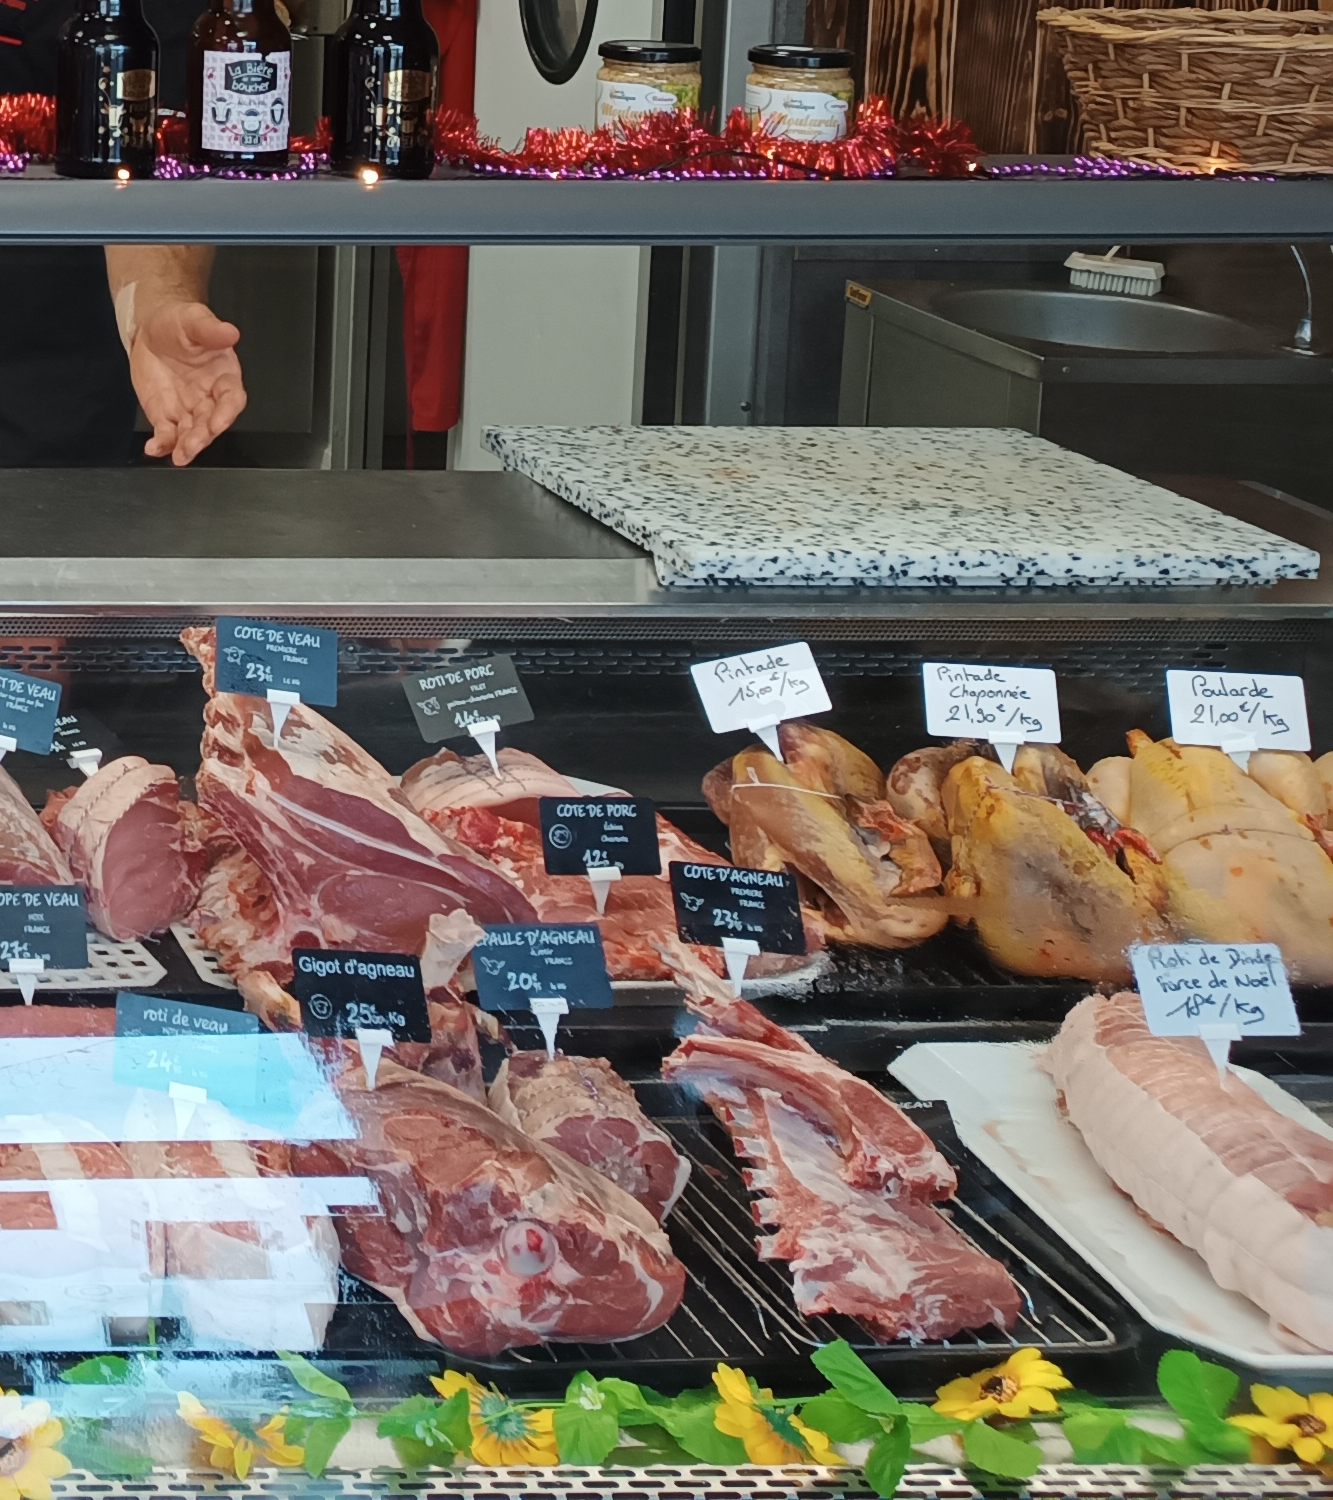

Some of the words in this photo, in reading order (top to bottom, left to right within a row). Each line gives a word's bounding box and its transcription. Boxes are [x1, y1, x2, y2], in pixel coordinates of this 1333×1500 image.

[228, 65, 241, 77] La
[246, 62, 274, 76] Bière
[231, 81, 270, 94] boucher
[233, 625, 265, 641] COTE
[265, 629, 285, 644] DE
[287, 631, 321, 649] VEAU
[282, 654, 309, 665] FRANCE
[714, 654, 790, 683] Pintade
[418, 672, 446, 691] ROTI
[445, 670, 464, 685] DE
[463, 663, 495, 681] PORC
[936, 665, 1007, 683] Pintade
[8, 679, 25, 694] DE
[27, 683, 57, 702] VEAU
[494, 686, 519, 698] FRANCE
[949, 683, 1032, 707] Chaponnée
[1191, 674, 1275, 699] Poularde
[5, 701, 29, 713] FRANCE
[556, 804, 586, 818] COTE
[586, 804, 605, 818] DE
[606, 804, 637, 818] PORC
[683, 864, 716, 881] COTE
[716, 867, 784, 888] D'AGNEAU
[21, 892, 42, 907] DE
[44, 892, 80, 907] VEAU
[738, 899, 766, 909] FRANCE
[23, 925, 51, 934] FRANCE
[524, 929, 596, 947] D'AGNEAU
[1198, 947, 1221, 967] de
[298, 956, 342, 977] Gigot
[344, 958, 416, 980] d'agneau
[1207, 969, 1229, 989] de
[1234, 970, 1277, 989] Noël
[143, 1007, 169, 1022] roti
[171, 1008, 190, 1026] de
[192, 1016, 229, 1034] veau
[388, 1011, 406, 1027] Kg
